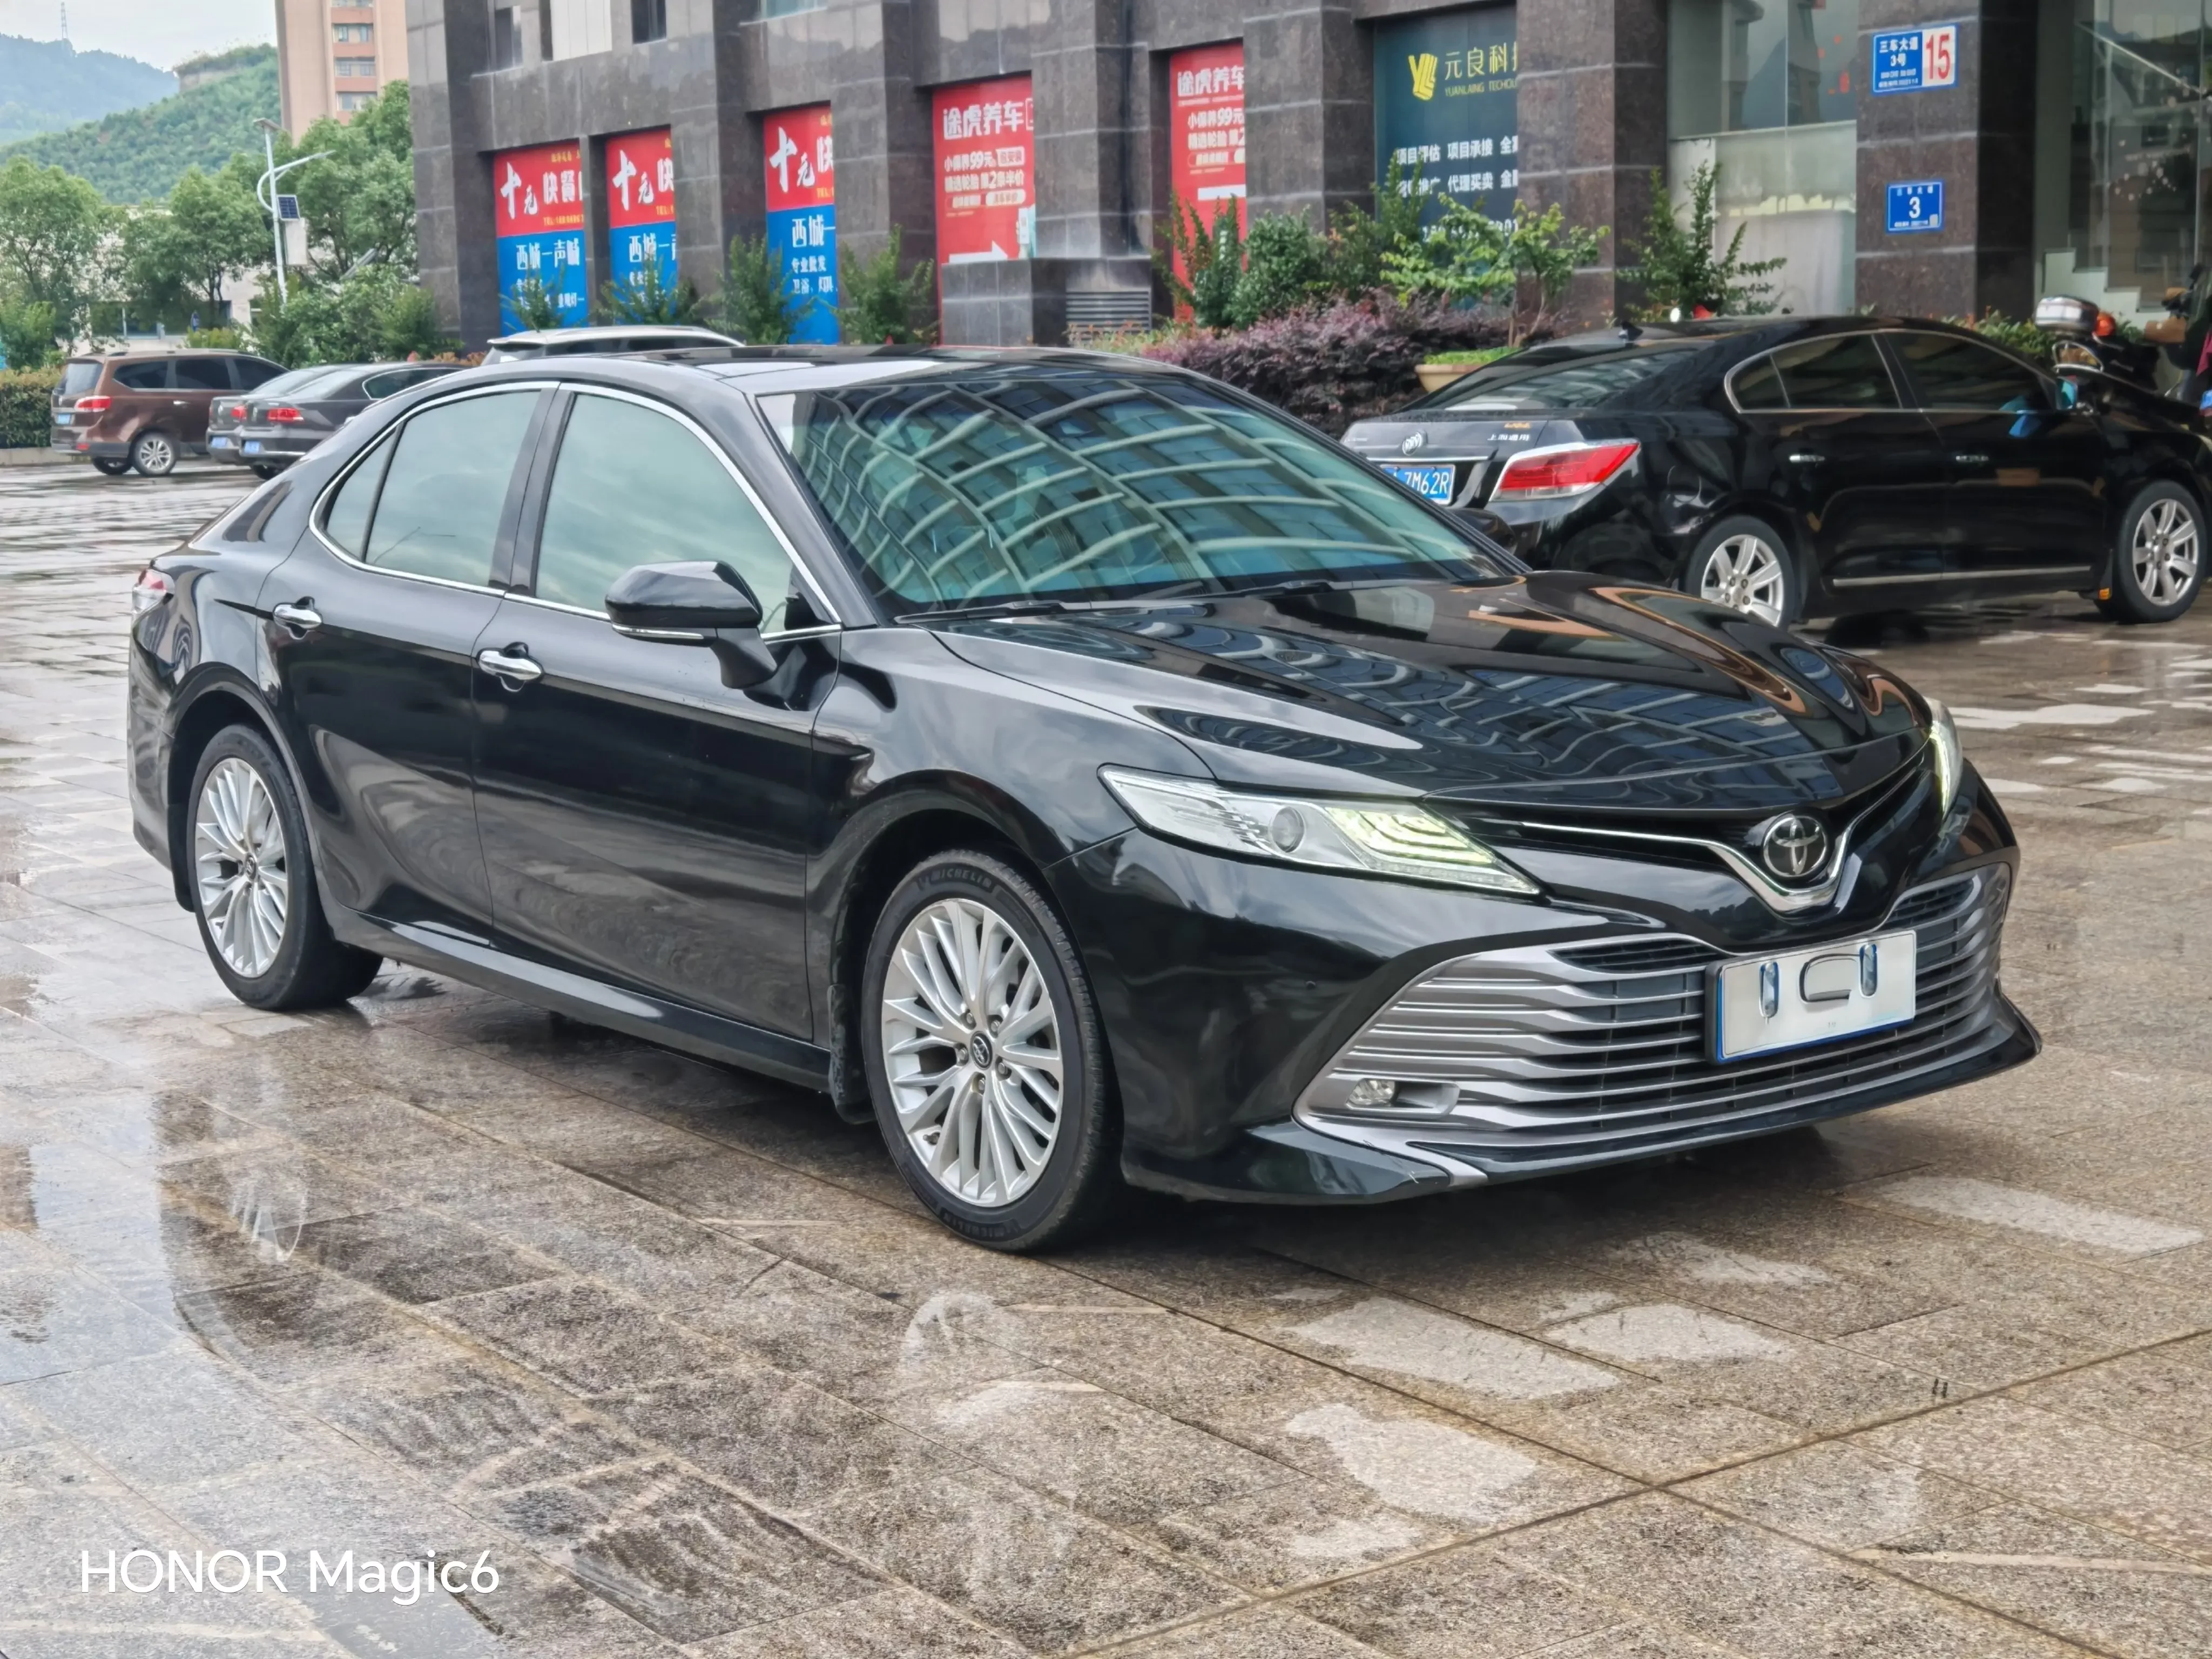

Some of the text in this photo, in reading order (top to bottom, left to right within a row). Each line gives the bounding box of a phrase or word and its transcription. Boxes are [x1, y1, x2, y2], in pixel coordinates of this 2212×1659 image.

[1926, 33, 1951, 80] 15
[1177, 65, 1245, 97] 途虎养车
[943, 100, 1024, 140] 途虎养车
[500, 161, 583, 220] 十元快餐
[1909, 196, 1920, 219] 3
[1393, 471, 1449, 495] 7M62R
